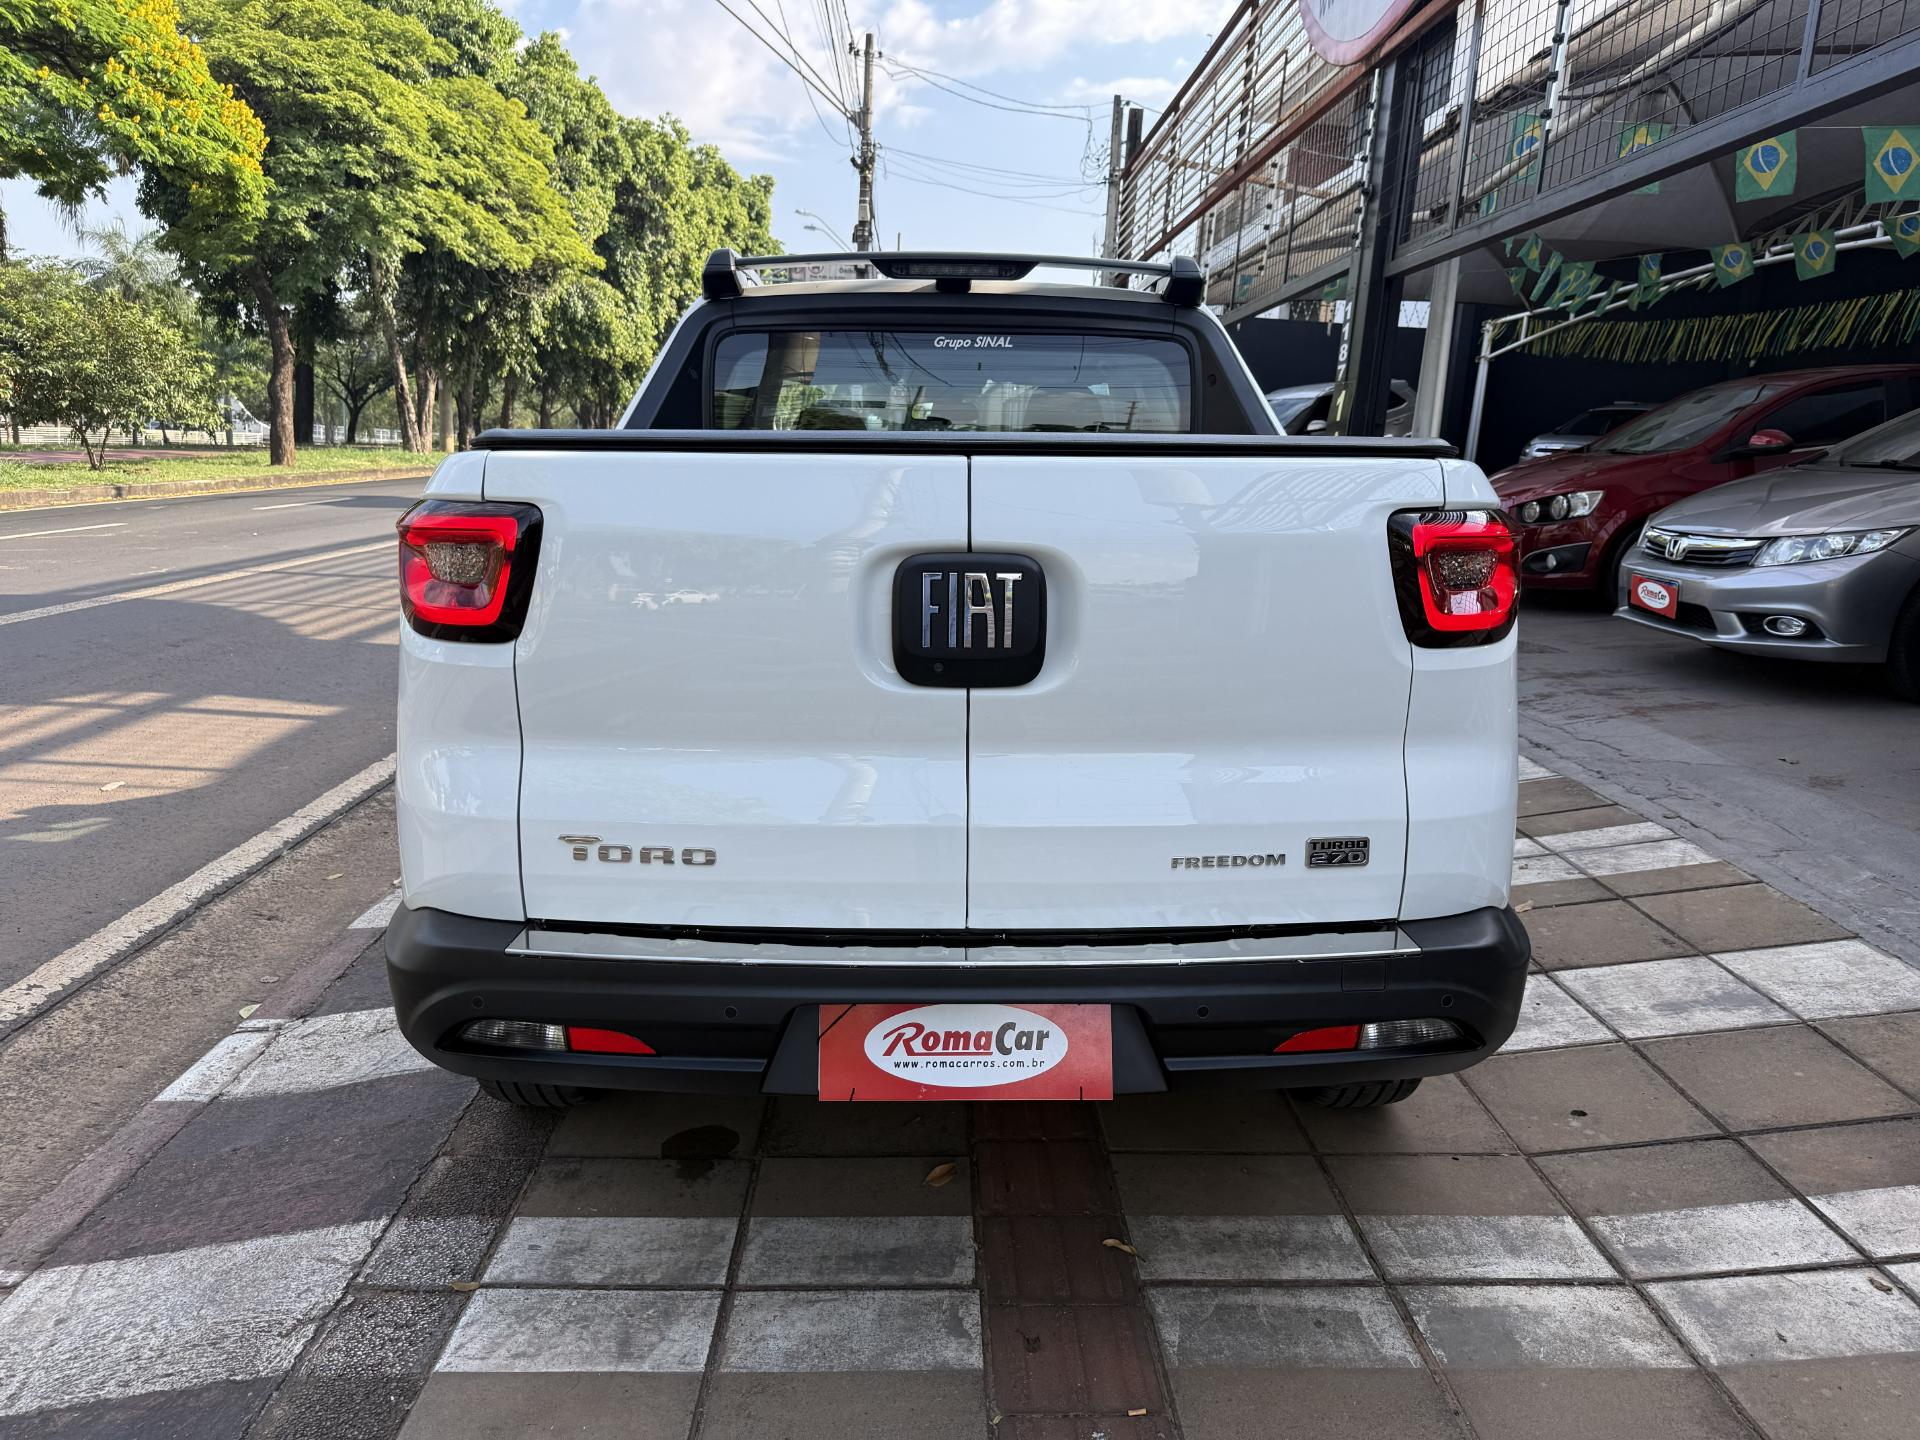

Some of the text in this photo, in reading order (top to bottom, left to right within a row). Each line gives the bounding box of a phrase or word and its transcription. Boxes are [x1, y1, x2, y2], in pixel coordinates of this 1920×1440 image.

[934, 335, 1013, 351] Grupo SINAL
[921, 572, 1023, 649] FIAT
[558, 833, 717, 866] TORO
[1310, 839, 1368, 851] TURBO
[1170, 853, 1287, 870] FREEDOM
[1311, 850, 1368, 865] 270
[882, 1021, 1050, 1057] RomaCar
[893, 1058, 1046, 1069] www.romacarros.com.br
